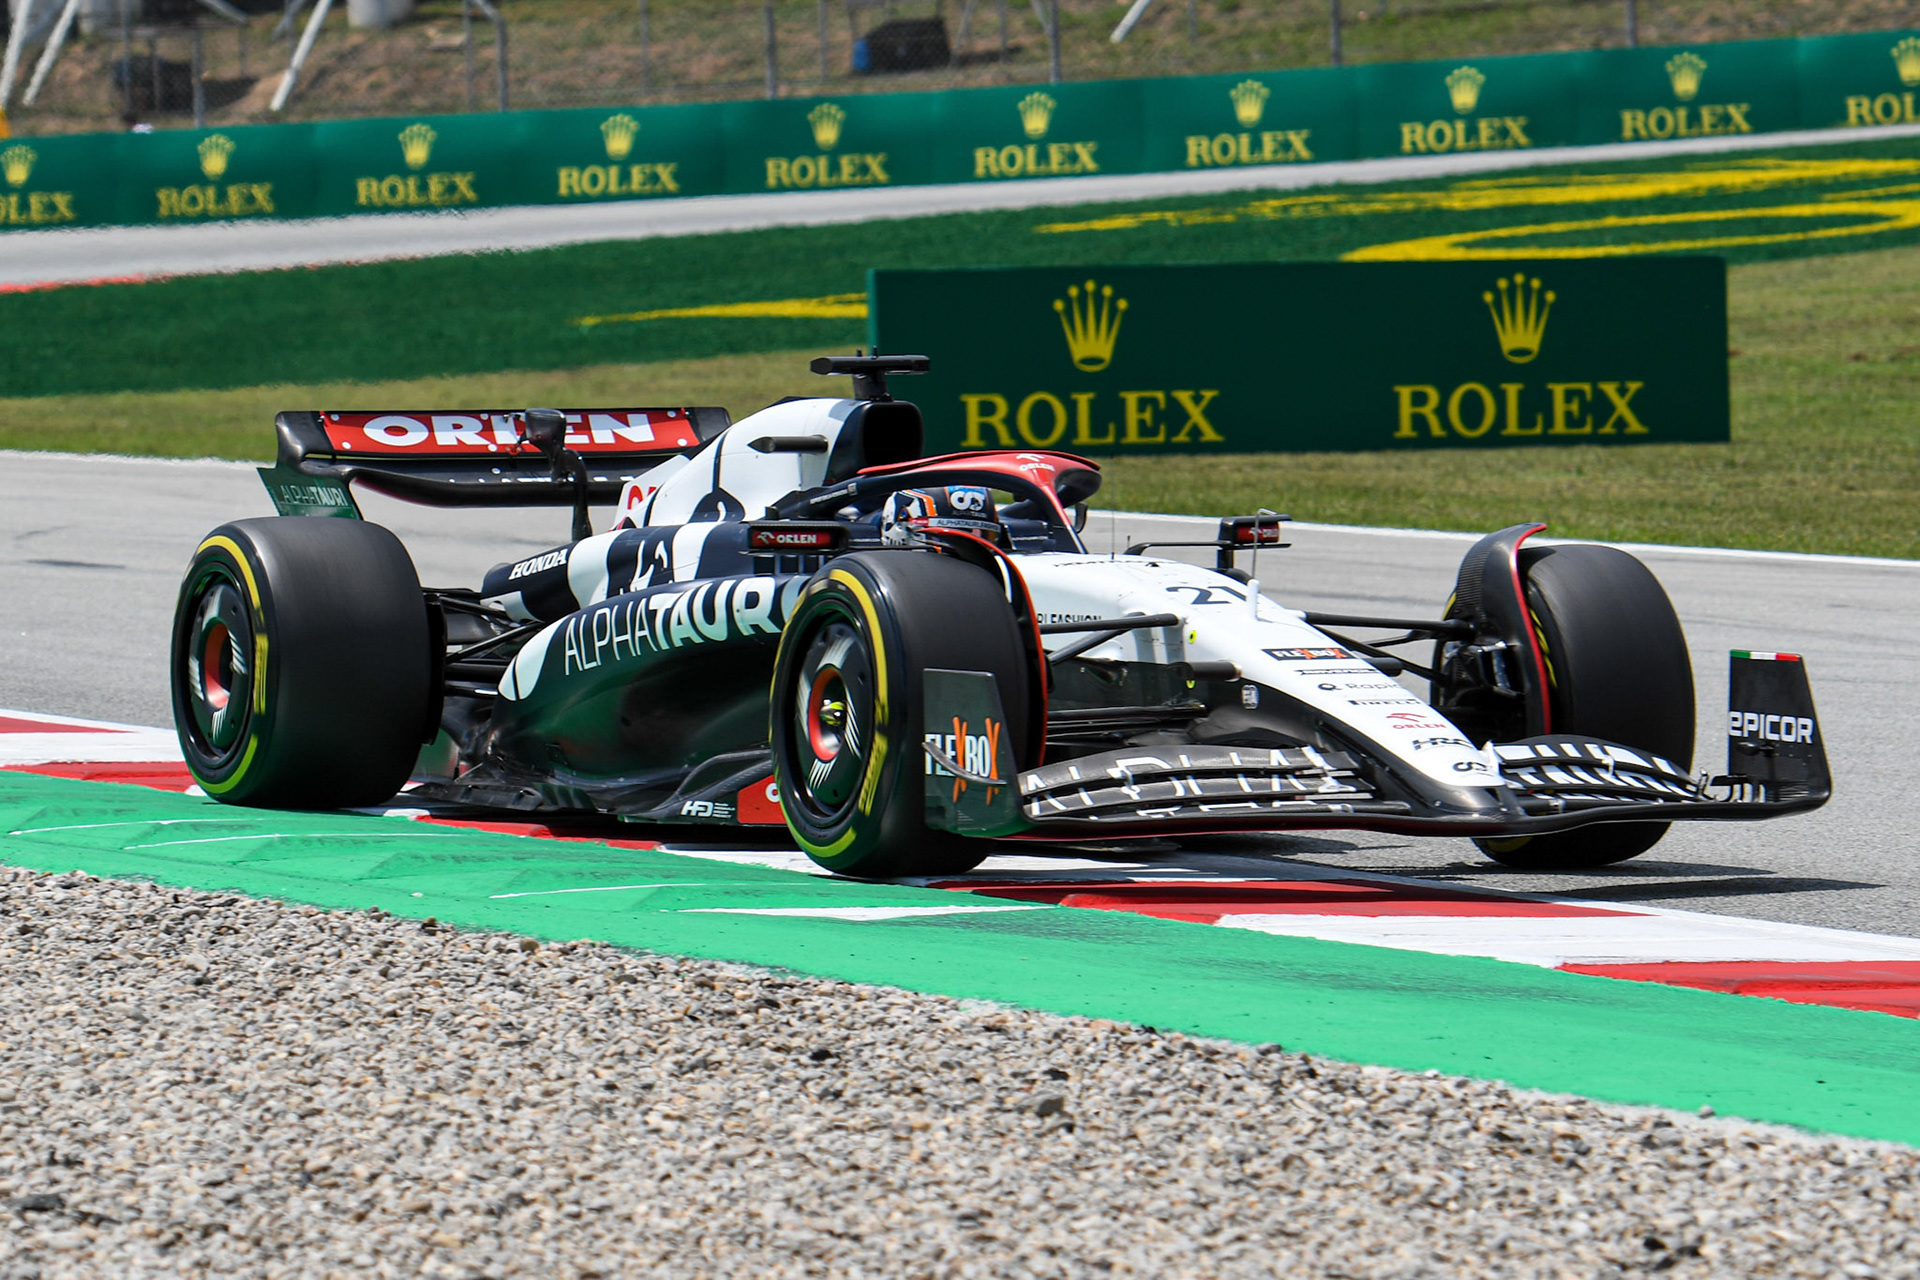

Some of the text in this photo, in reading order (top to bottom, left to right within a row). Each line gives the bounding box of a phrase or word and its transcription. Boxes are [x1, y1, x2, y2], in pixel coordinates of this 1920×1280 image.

[1400, 117, 1531, 153] ROLEX
[1620, 104, 1752, 140] ROLEX
[974, 142, 1098, 178] ROLEX
[1185, 130, 1312, 166] ROLEX
[557, 163, 679, 197] ROLEX
[765, 154, 890, 188] ROLEX
[0, 191, 75, 223] LEX
[157, 183, 273, 217] ROLEX
[356, 174, 477, 206] ROLEX
[961, 389, 1225, 447] ROLEX
[1393, 380, 1649, 438] ROLEX
[776, 534, 817, 544] ORLEN
[508, 548, 568, 580] HONDA
[1165, 585, 1248, 604] 21
